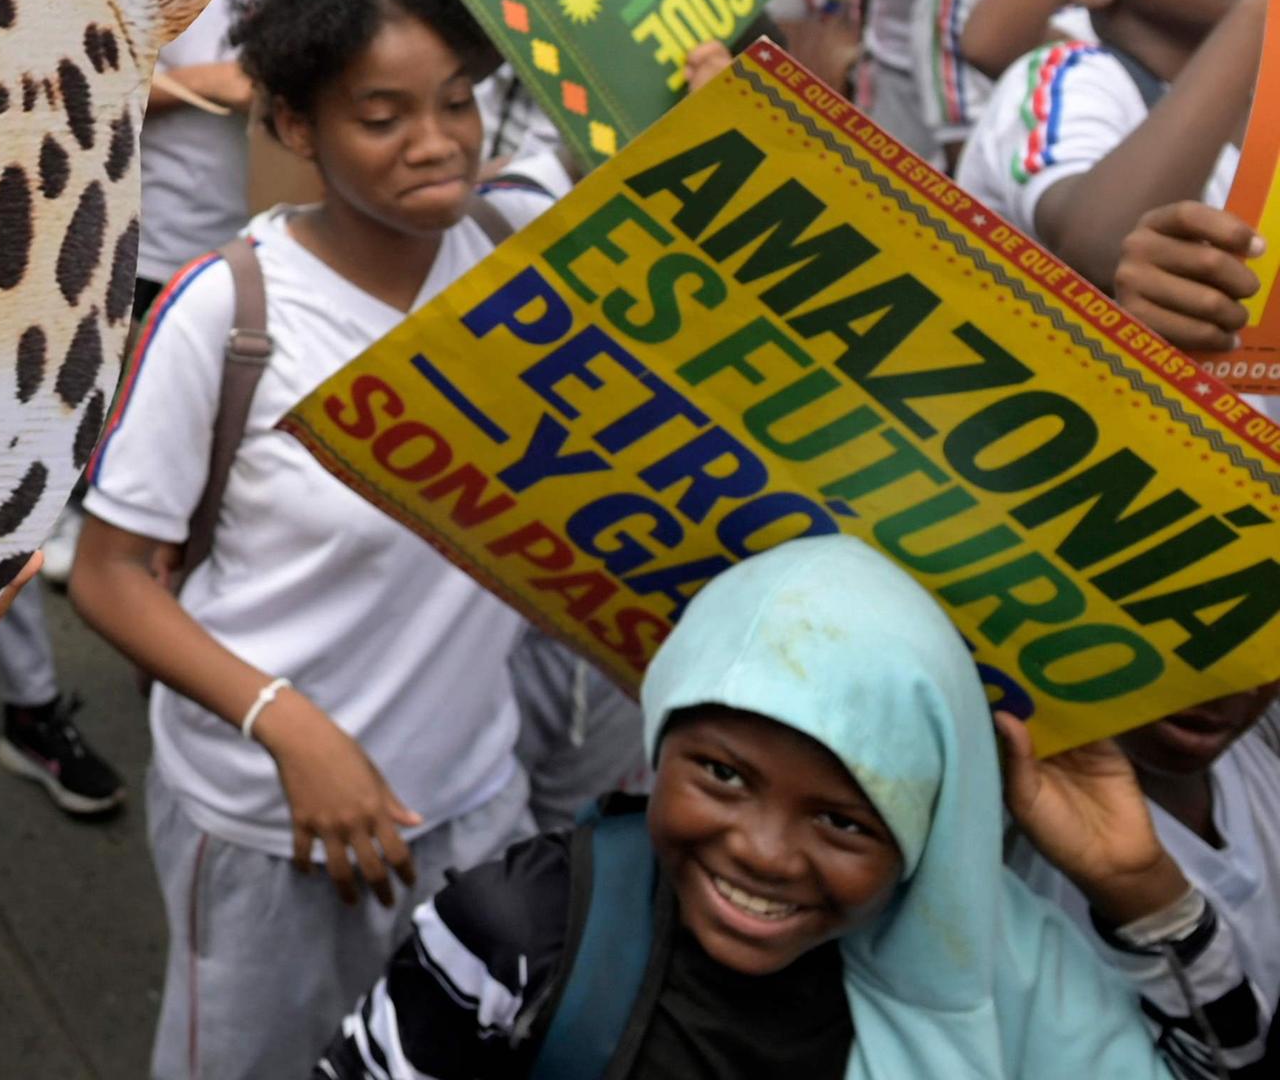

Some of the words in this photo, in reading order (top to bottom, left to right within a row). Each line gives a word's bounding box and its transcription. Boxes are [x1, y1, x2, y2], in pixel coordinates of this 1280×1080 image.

[541, 192, 728, 345] ES
[674, 316, 1165, 703] FUTURO
[624, 128, 1280, 672] AMAZONÍA
[775, 60, 806, 88] DE
[844, 115, 900, 160] LADO
[991, 225, 1024, 253] DE
[1062, 281, 1120, 327] LADO
[1213, 393, 1251, 423] DE
[323, 374, 516, 531] SON
[485, 521, 673, 673] PAS
